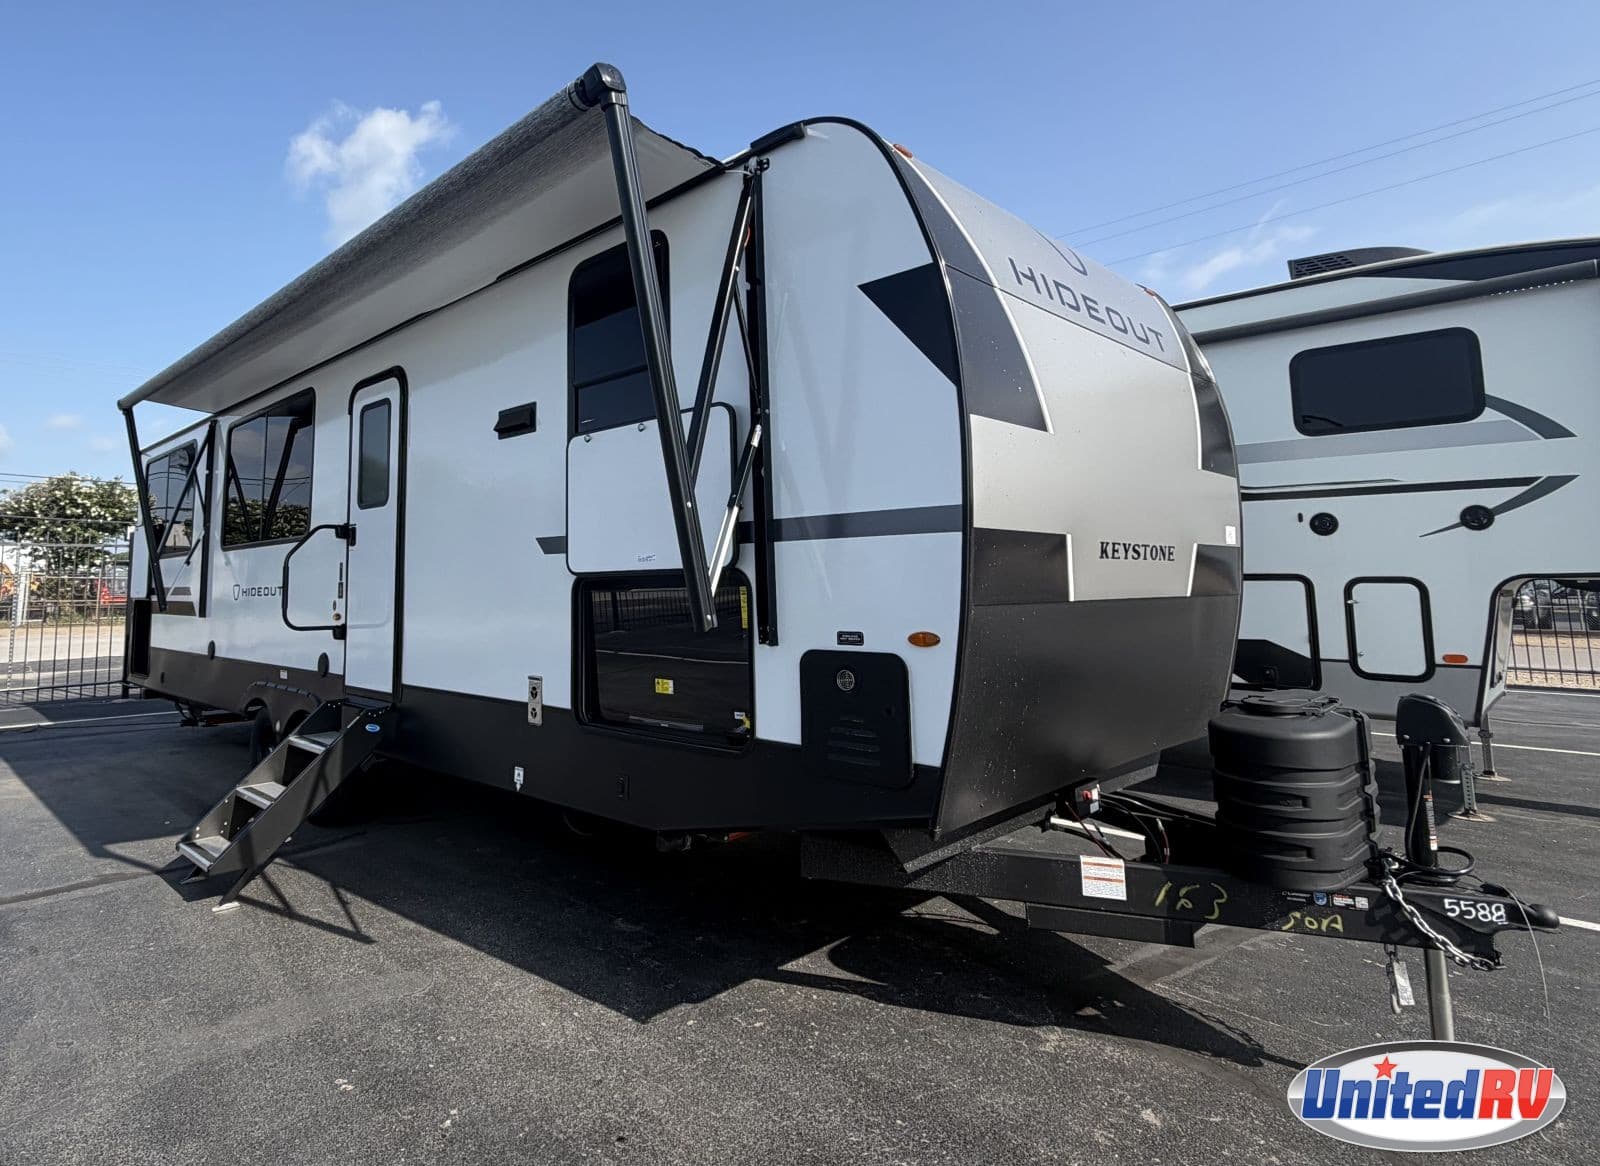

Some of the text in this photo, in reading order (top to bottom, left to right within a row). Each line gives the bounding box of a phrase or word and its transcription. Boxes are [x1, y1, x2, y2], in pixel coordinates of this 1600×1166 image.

[1008, 257, 1165, 352] HIDEOUT
[1099, 541, 1175, 561] KEYSTONE
[241, 586, 283, 597] HIDEOUT
